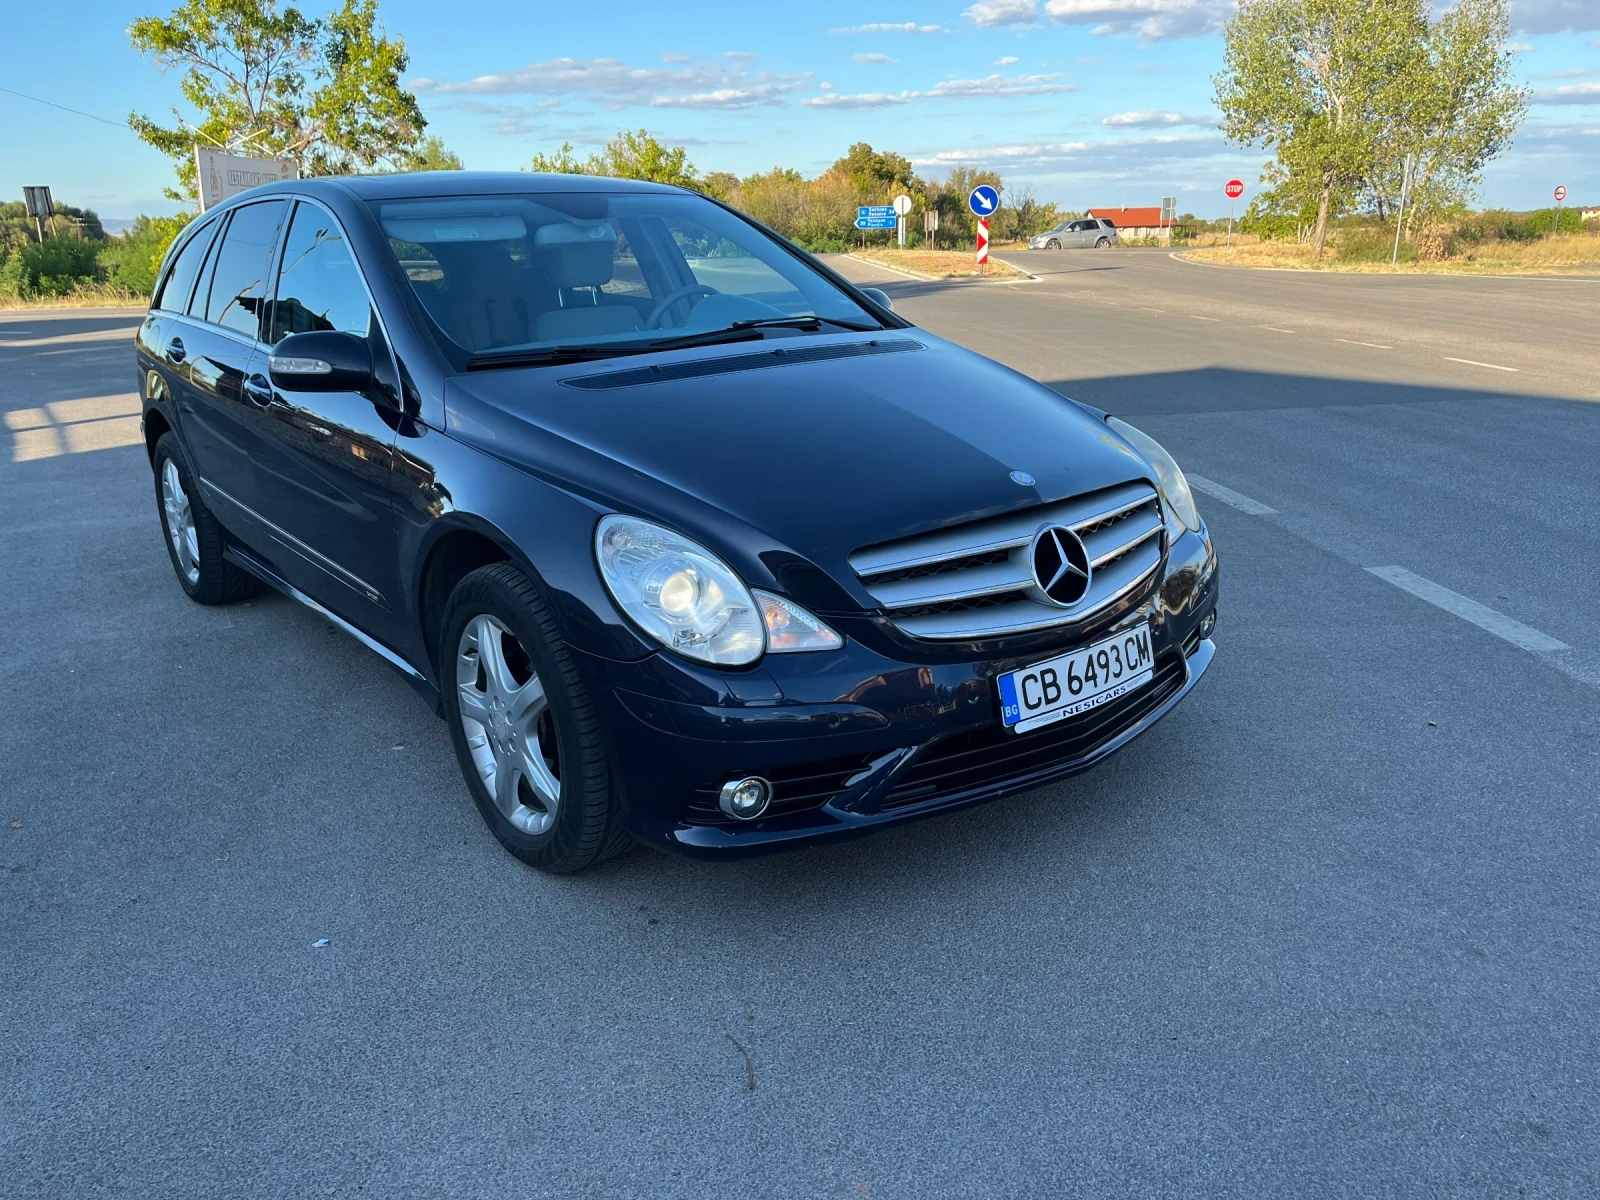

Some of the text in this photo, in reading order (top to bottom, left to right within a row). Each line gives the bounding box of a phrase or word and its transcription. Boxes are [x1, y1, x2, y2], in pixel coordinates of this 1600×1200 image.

[1021, 630, 1151, 710] CB 6493 CM
[1005, 704, 1018, 718] BG
[1062, 685, 1127, 718] NESICARS
